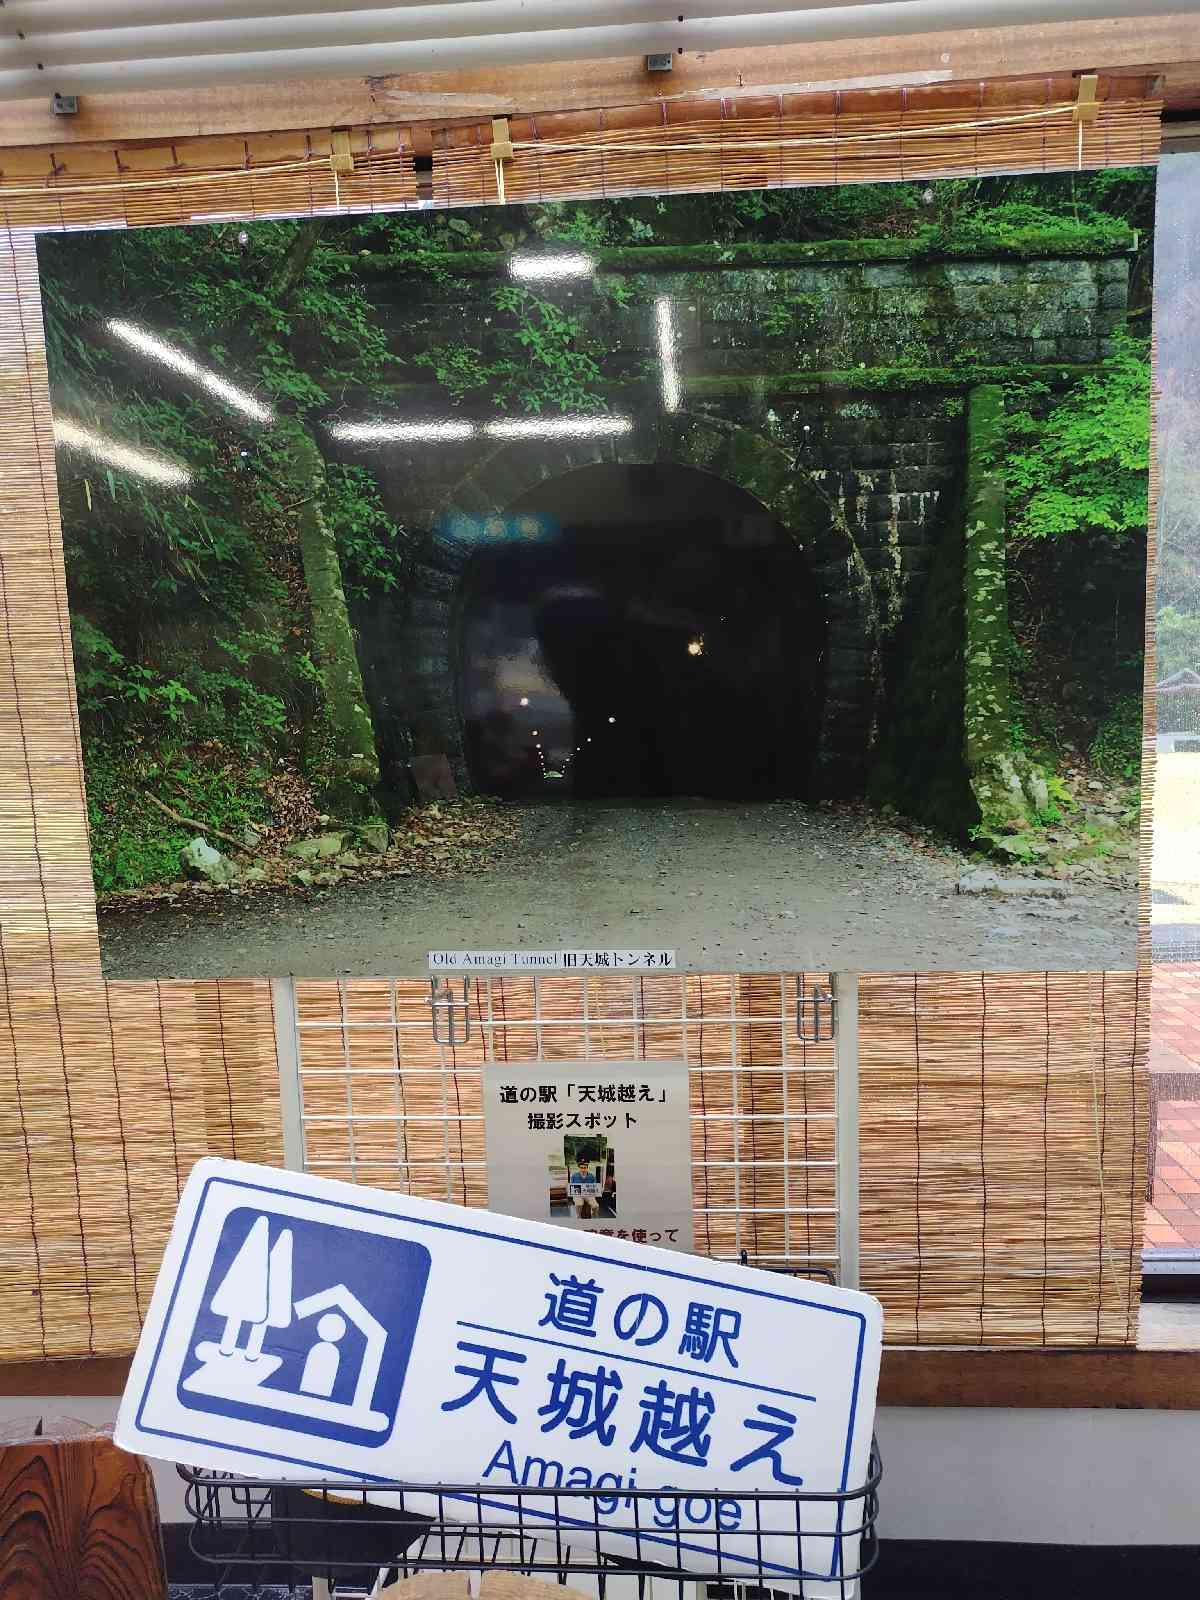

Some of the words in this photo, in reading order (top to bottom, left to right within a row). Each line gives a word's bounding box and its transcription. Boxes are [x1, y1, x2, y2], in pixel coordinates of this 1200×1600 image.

[433, 953, 457, 964] Old
[463, 953, 506, 967] Amagi
[511, 953, 558, 965] Tunnel
[563, 952, 673, 967] 旧天城トンネル
[500, 1084, 670, 1103] 道の駅「天城越え」
[527, 1112, 637, 1130] 撮影スポット
[538, 1272, 742, 1368] 道の駅
[441, 1340, 803, 1486] 天城越え
